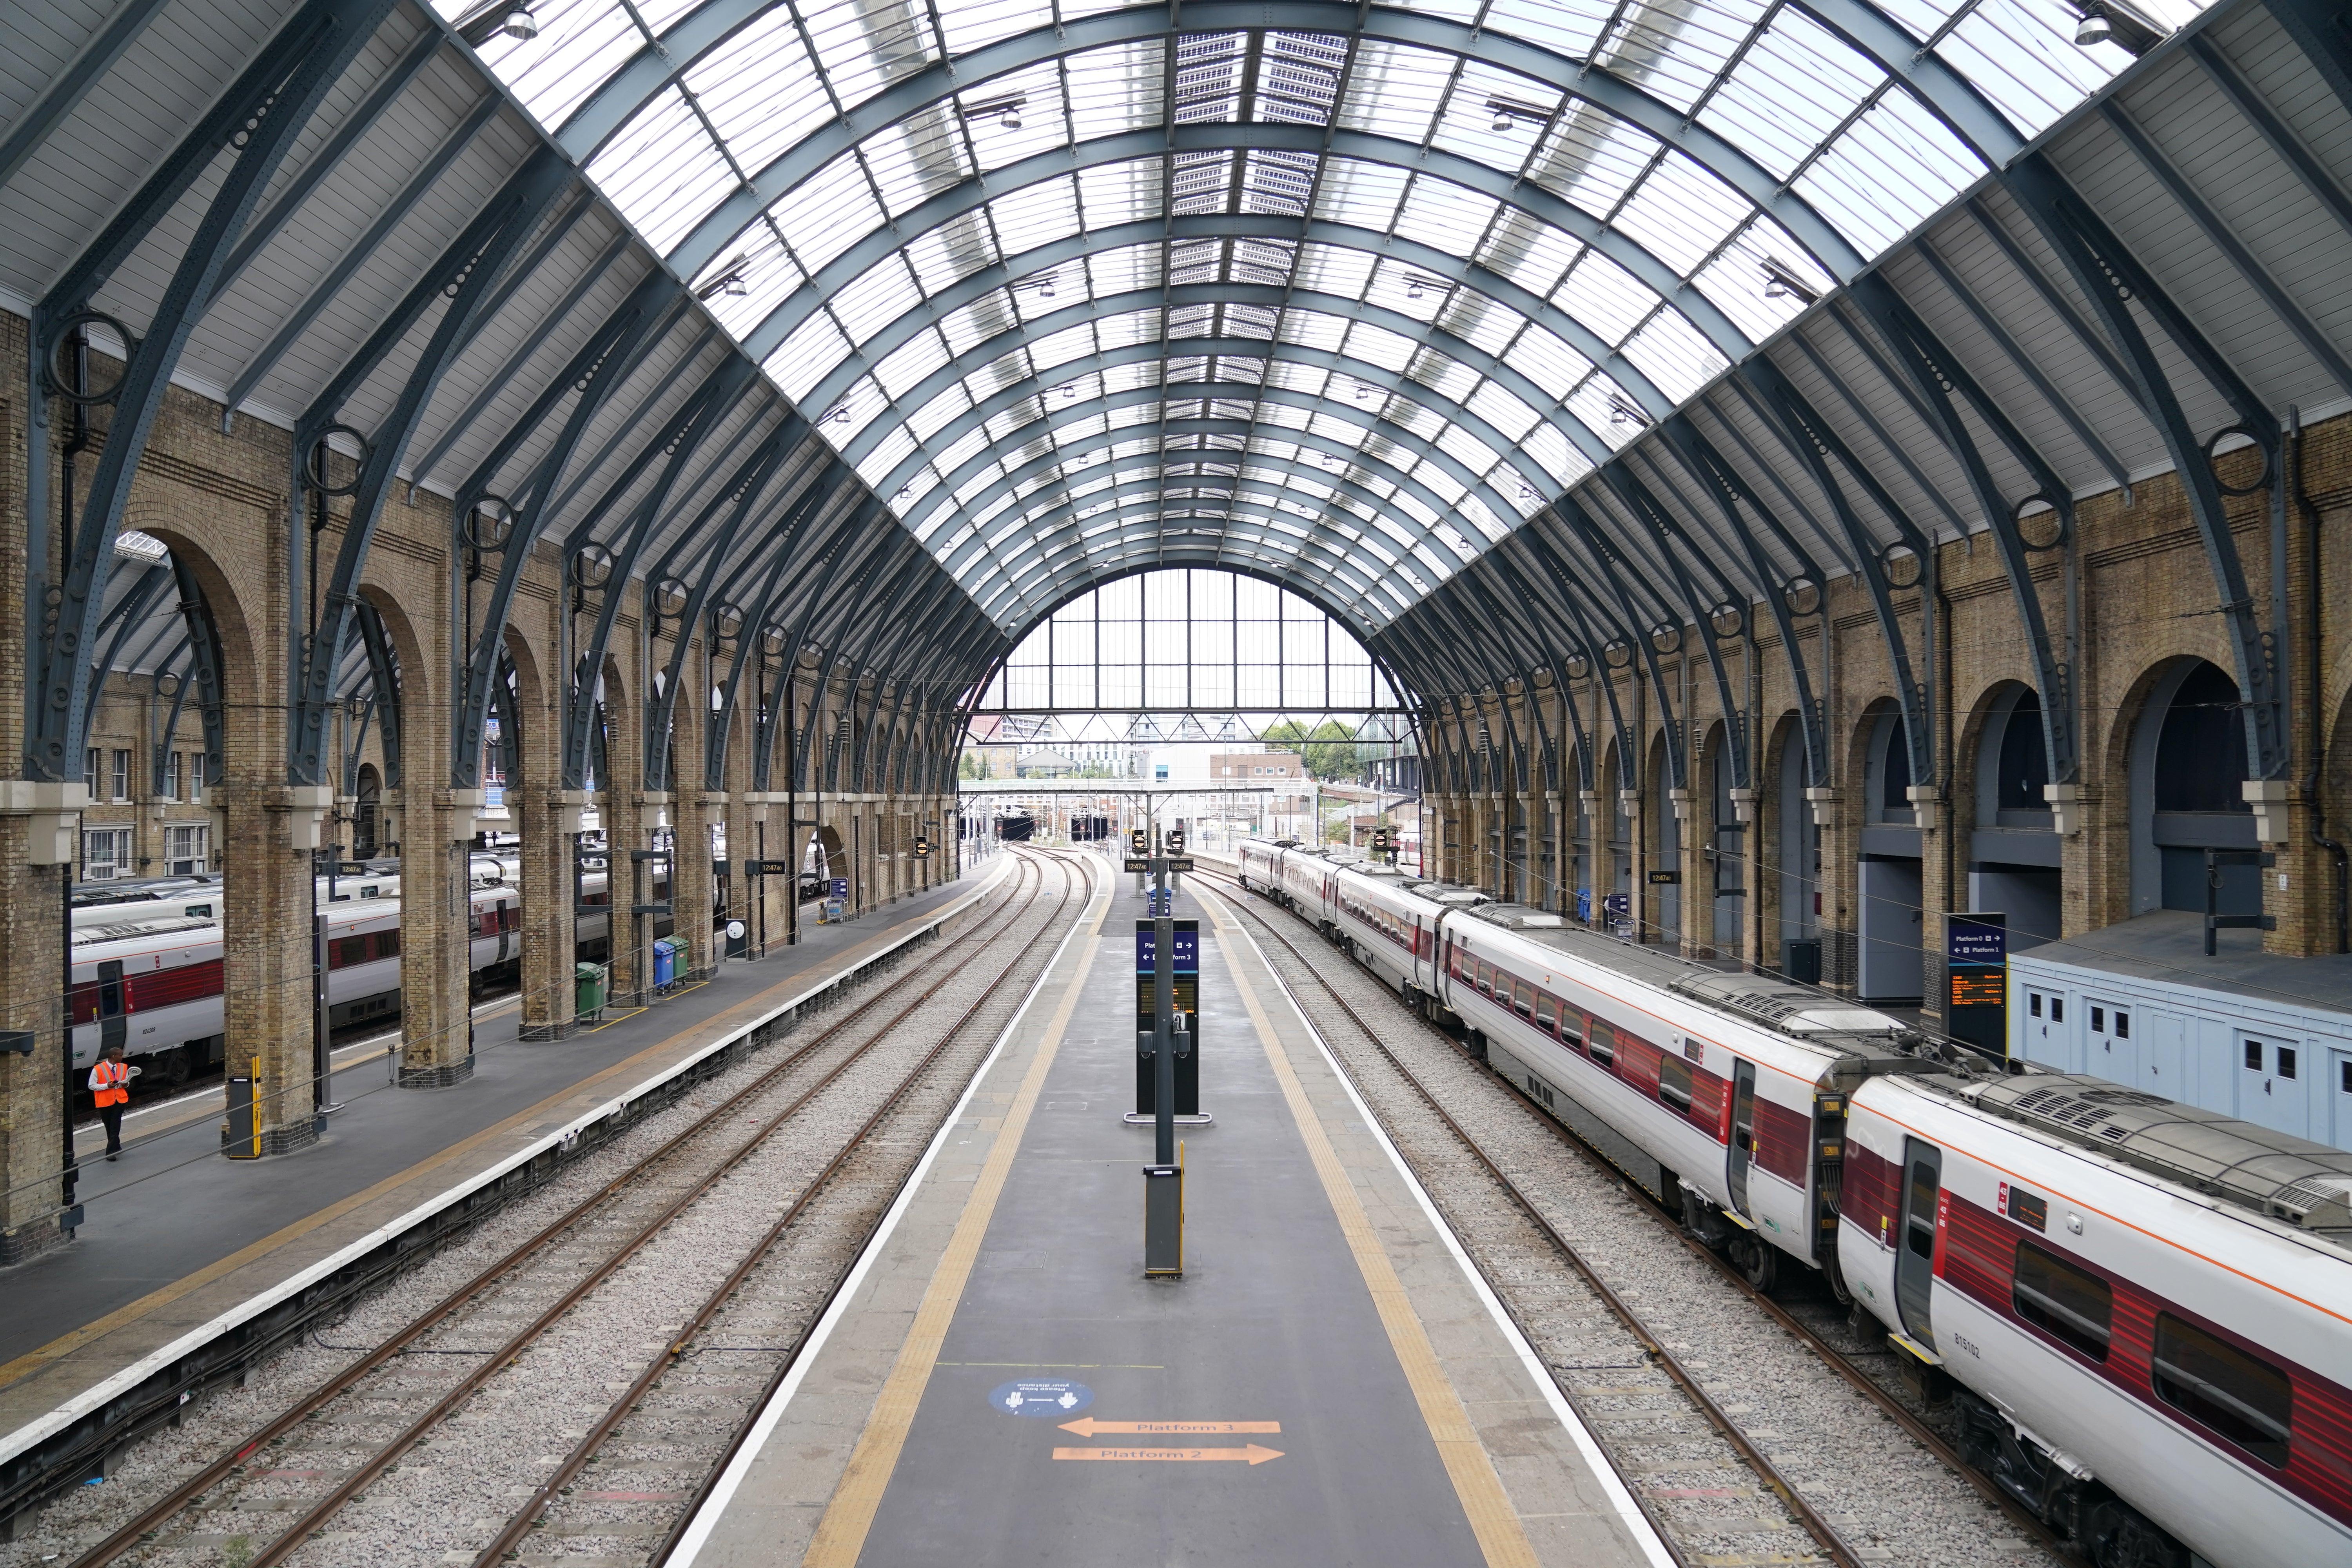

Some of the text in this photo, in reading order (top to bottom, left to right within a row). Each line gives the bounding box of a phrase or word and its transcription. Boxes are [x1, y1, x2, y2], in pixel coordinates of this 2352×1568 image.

[2000, 1187, 2007, 1196] 43
[1940, 1206, 1947, 1214] 43
[1954, 1332, 1980, 1359] 815102
